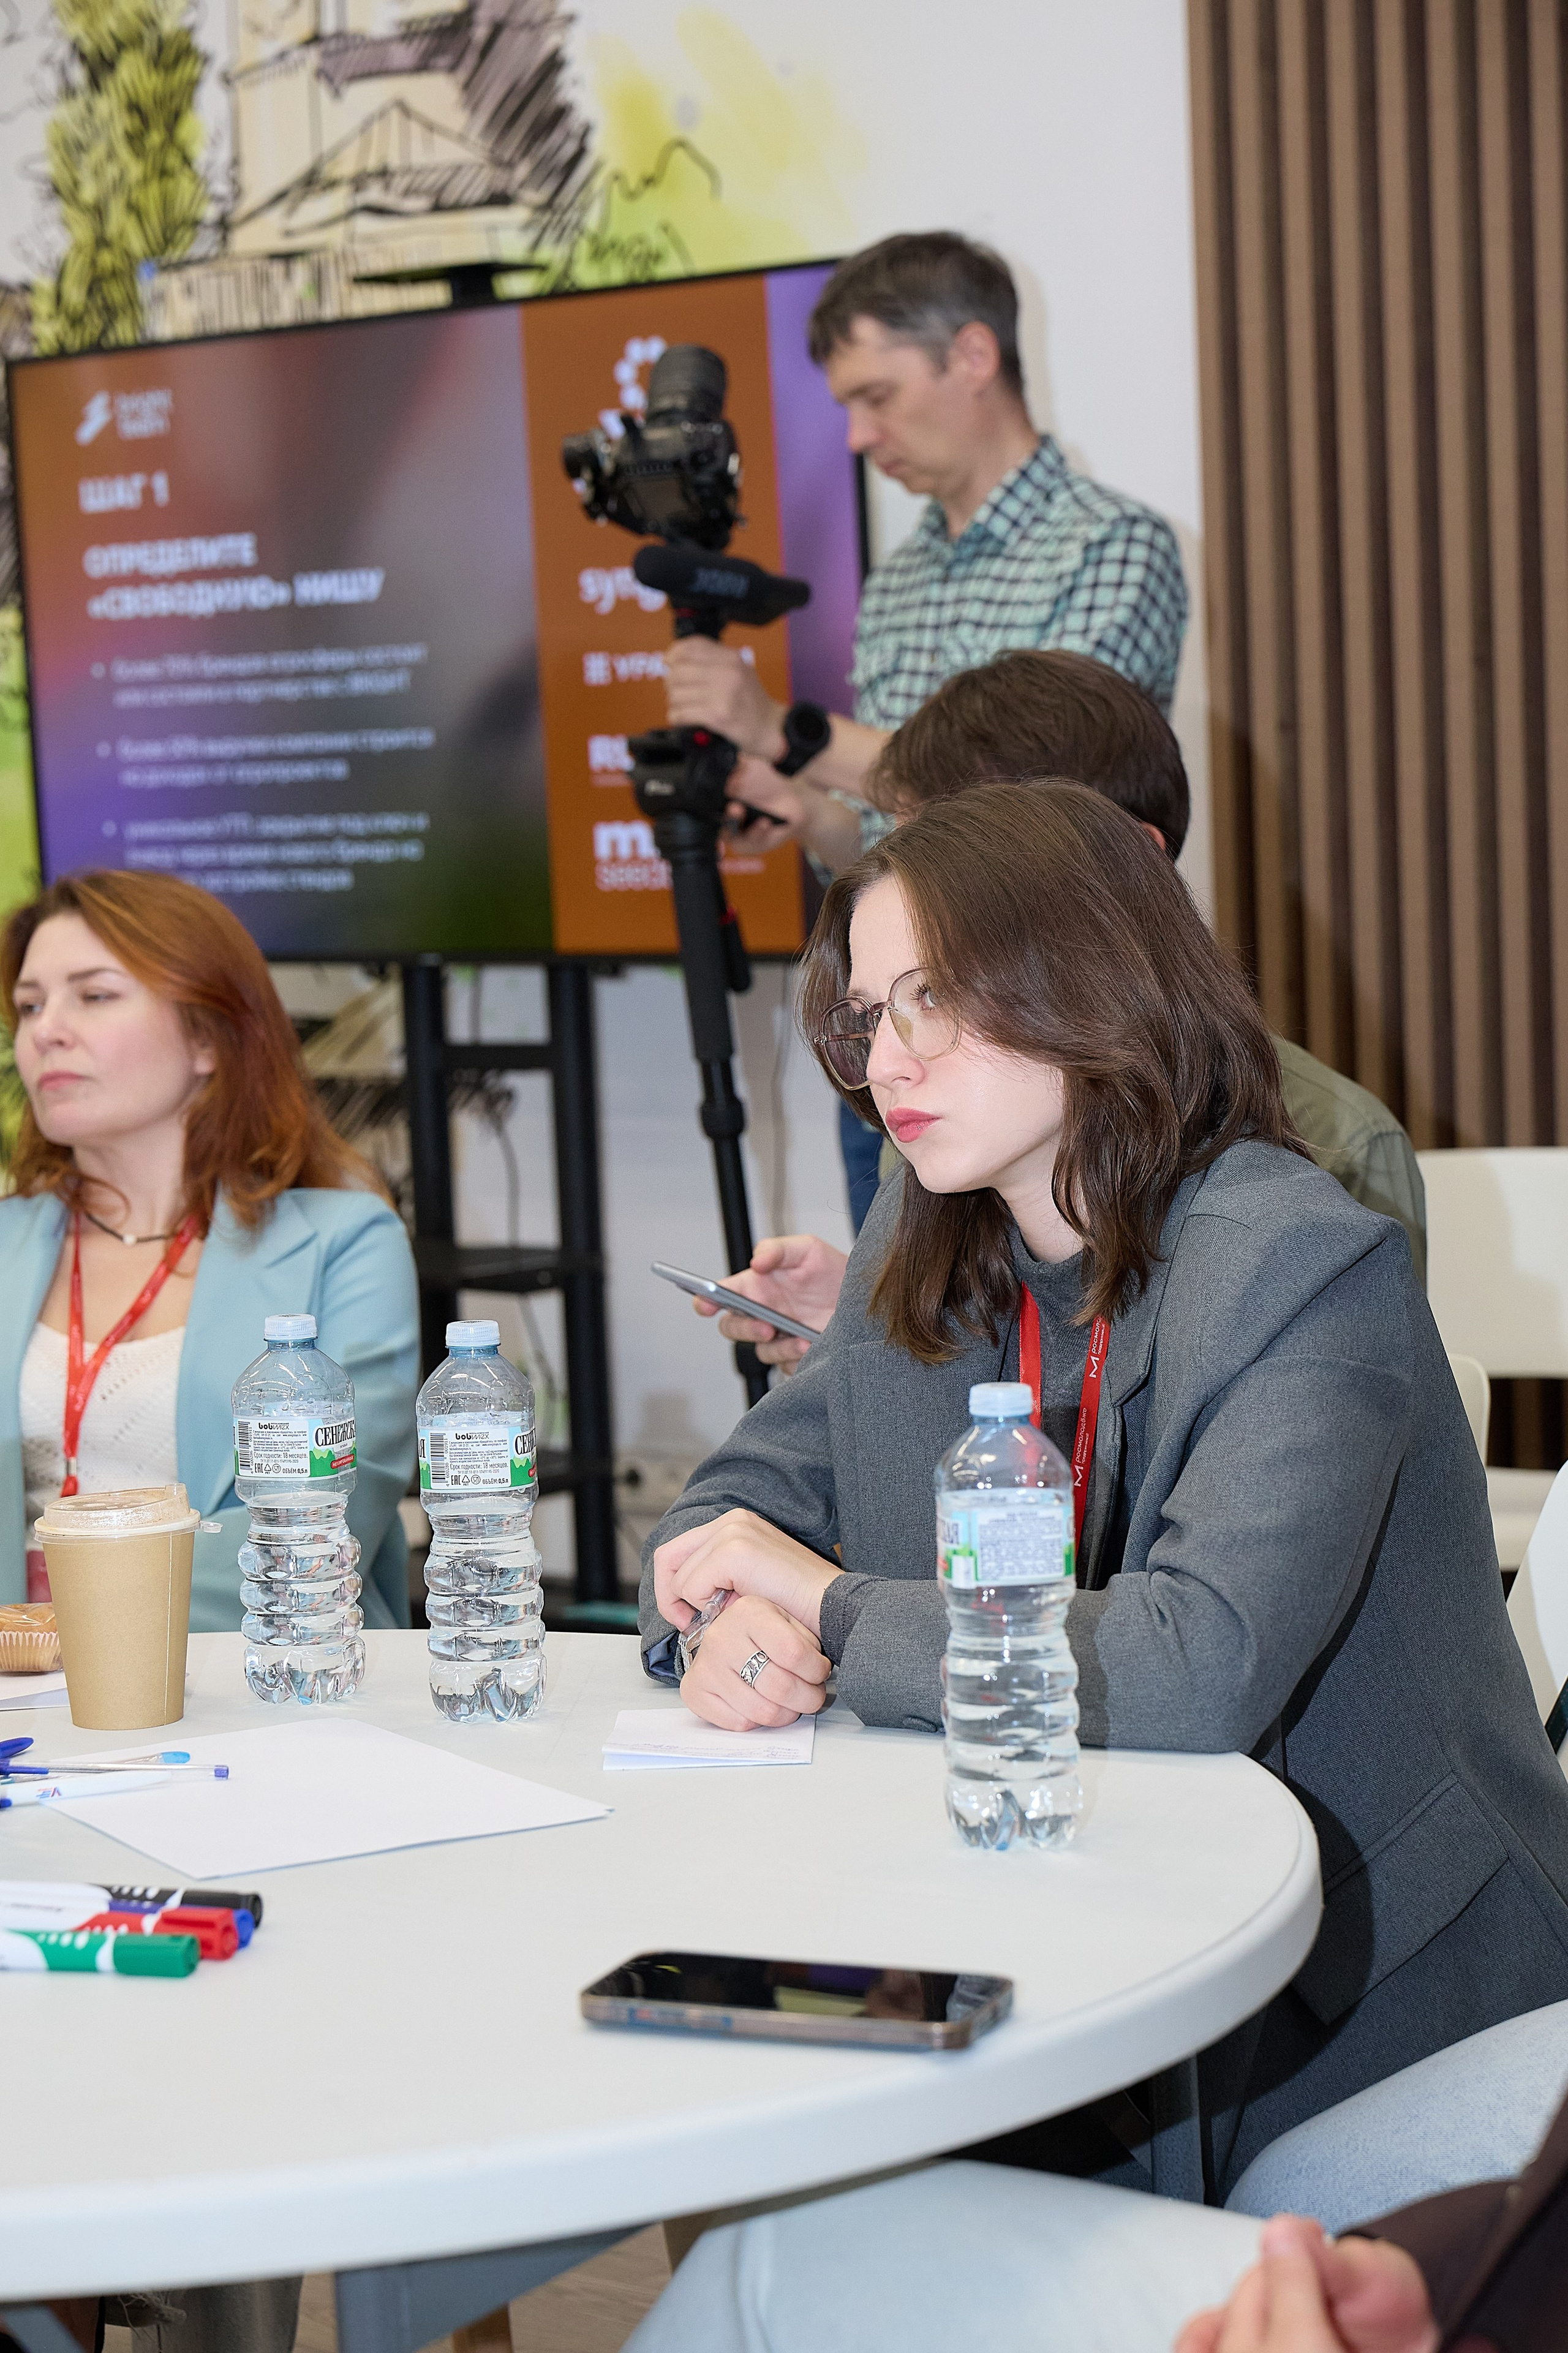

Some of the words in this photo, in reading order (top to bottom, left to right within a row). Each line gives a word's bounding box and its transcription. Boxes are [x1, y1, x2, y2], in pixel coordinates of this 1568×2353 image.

[80, 474, 146, 512] ШАГ
[153, 470, 168, 505] 1
[84, 533, 256, 578] ОПРЕДЕЛИТЕ
[295, 568, 383, 605] НИШУ
[1091, 1316, 1102, 1355] росмоло
[315, 1419, 356, 1446] СЕНЕЖСК
